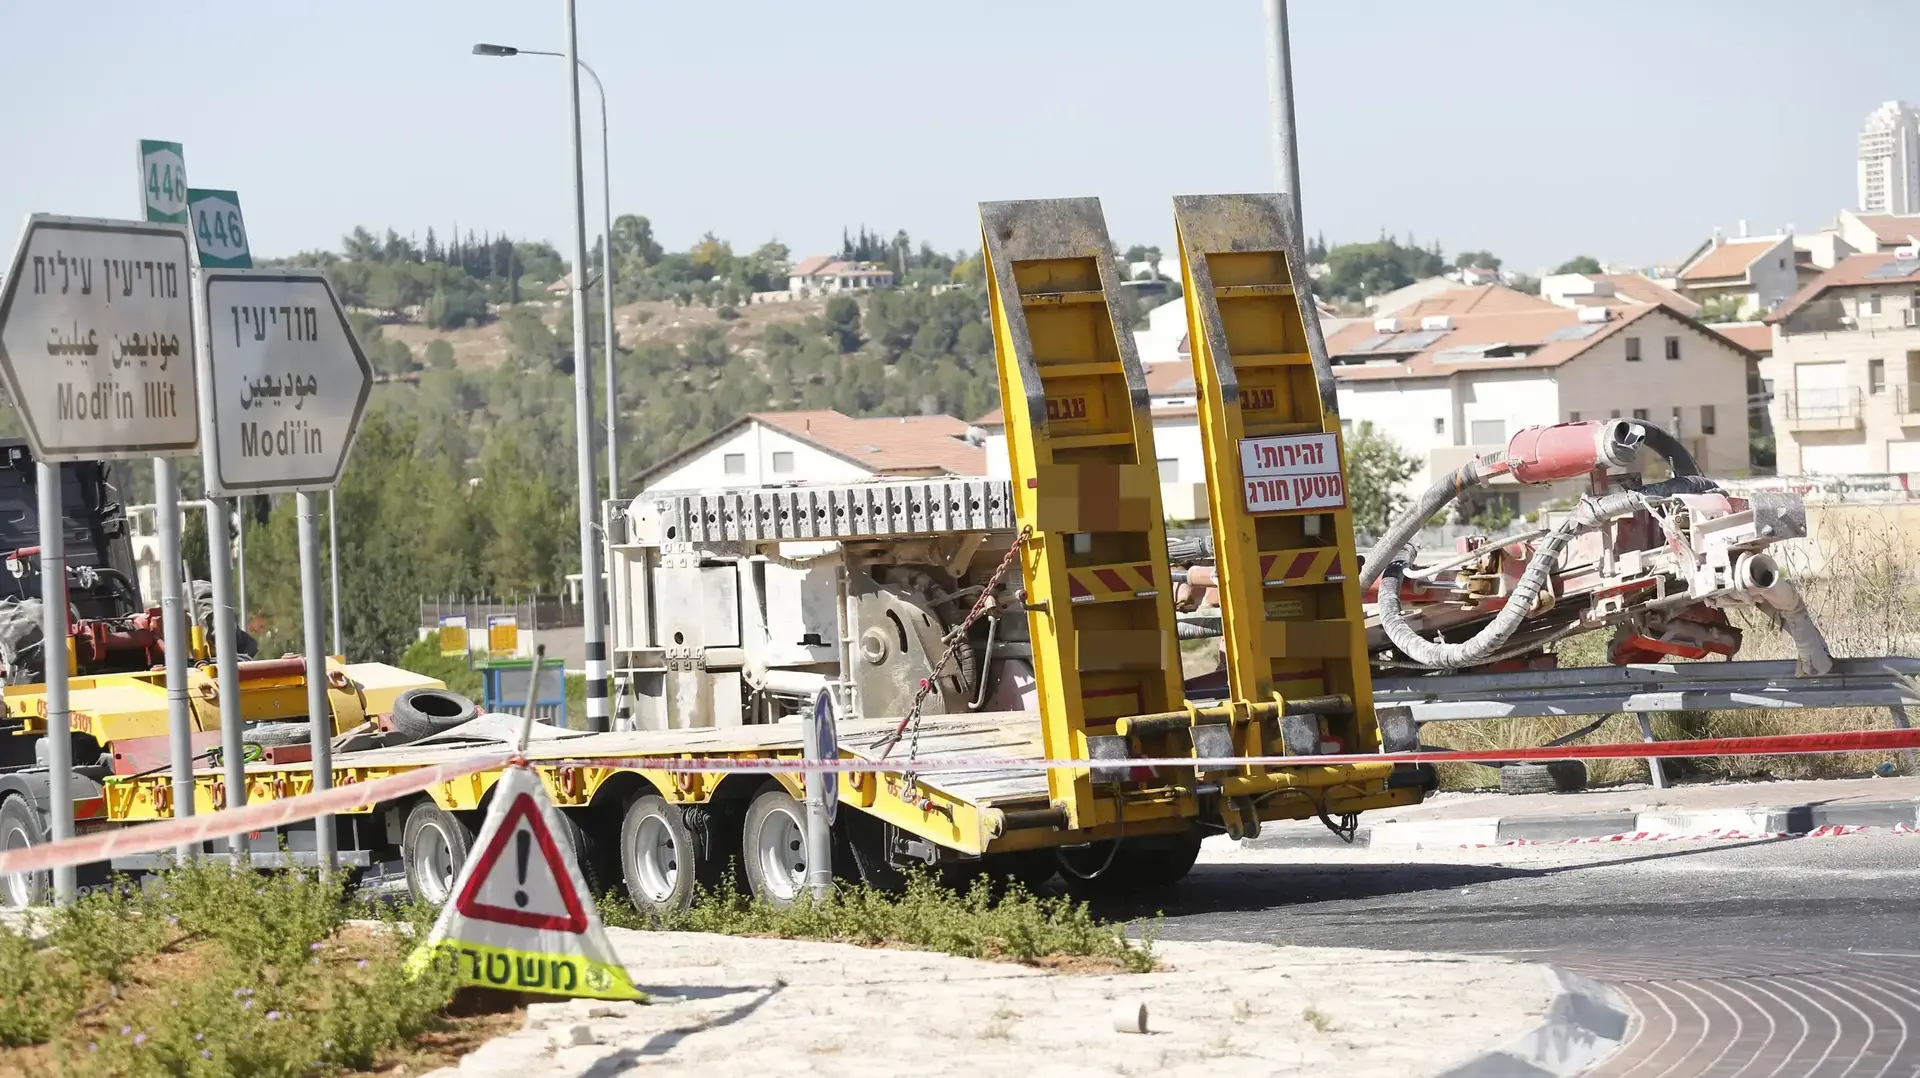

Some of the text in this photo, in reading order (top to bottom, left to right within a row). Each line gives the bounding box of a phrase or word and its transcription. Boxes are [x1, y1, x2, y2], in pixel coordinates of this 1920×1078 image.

[148, 162, 185, 203] 446
[199, 209, 243, 248] 446
[33, 249, 178, 303] מודיעין עילית
[46, 319, 180, 371] موديعين عيليت
[231, 306, 318, 348] מודיעין
[57, 381, 177, 420] Modi'in Illit
[240, 372, 318, 411] موديعين
[240, 420, 323, 457] Modi'in
[1253, 442, 1324, 469] זהירות!
[1247, 475, 1341, 506] מטען חורג
